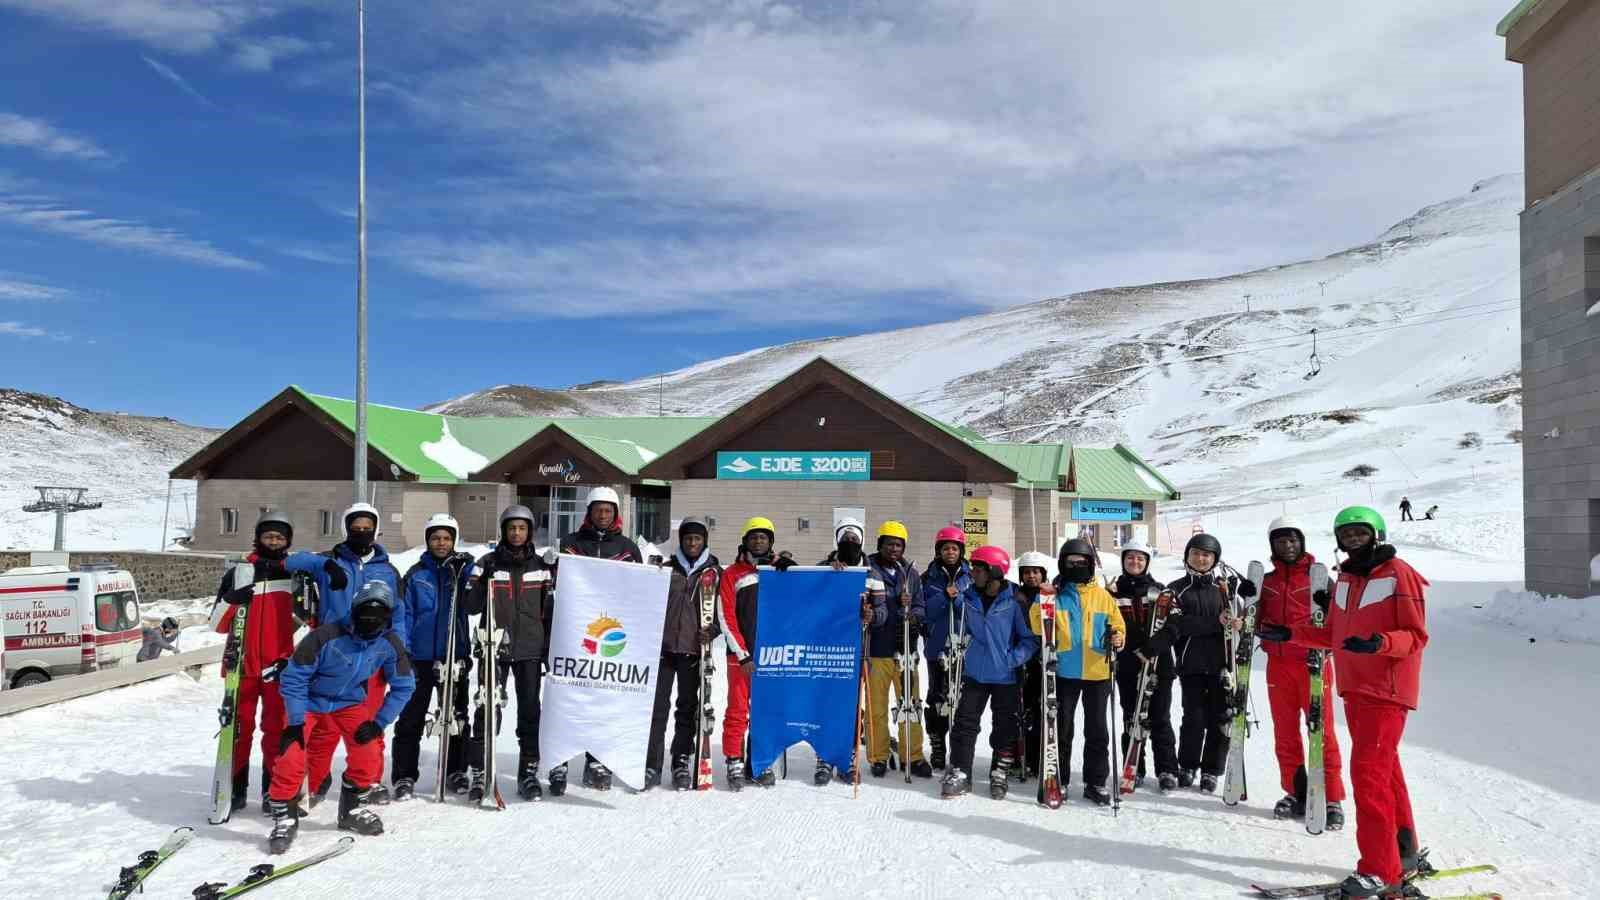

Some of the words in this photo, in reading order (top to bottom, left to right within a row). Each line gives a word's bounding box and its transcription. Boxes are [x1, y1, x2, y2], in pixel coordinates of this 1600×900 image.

[761, 457, 802, 473] EJDE
[811, 457, 851, 473] 3200
[25, 620, 48, 634] 112
[21, 634, 80, 648] AMBULANS
[758, 645, 806, 666] UDEF
[553, 656, 650, 685] ERZURUM
